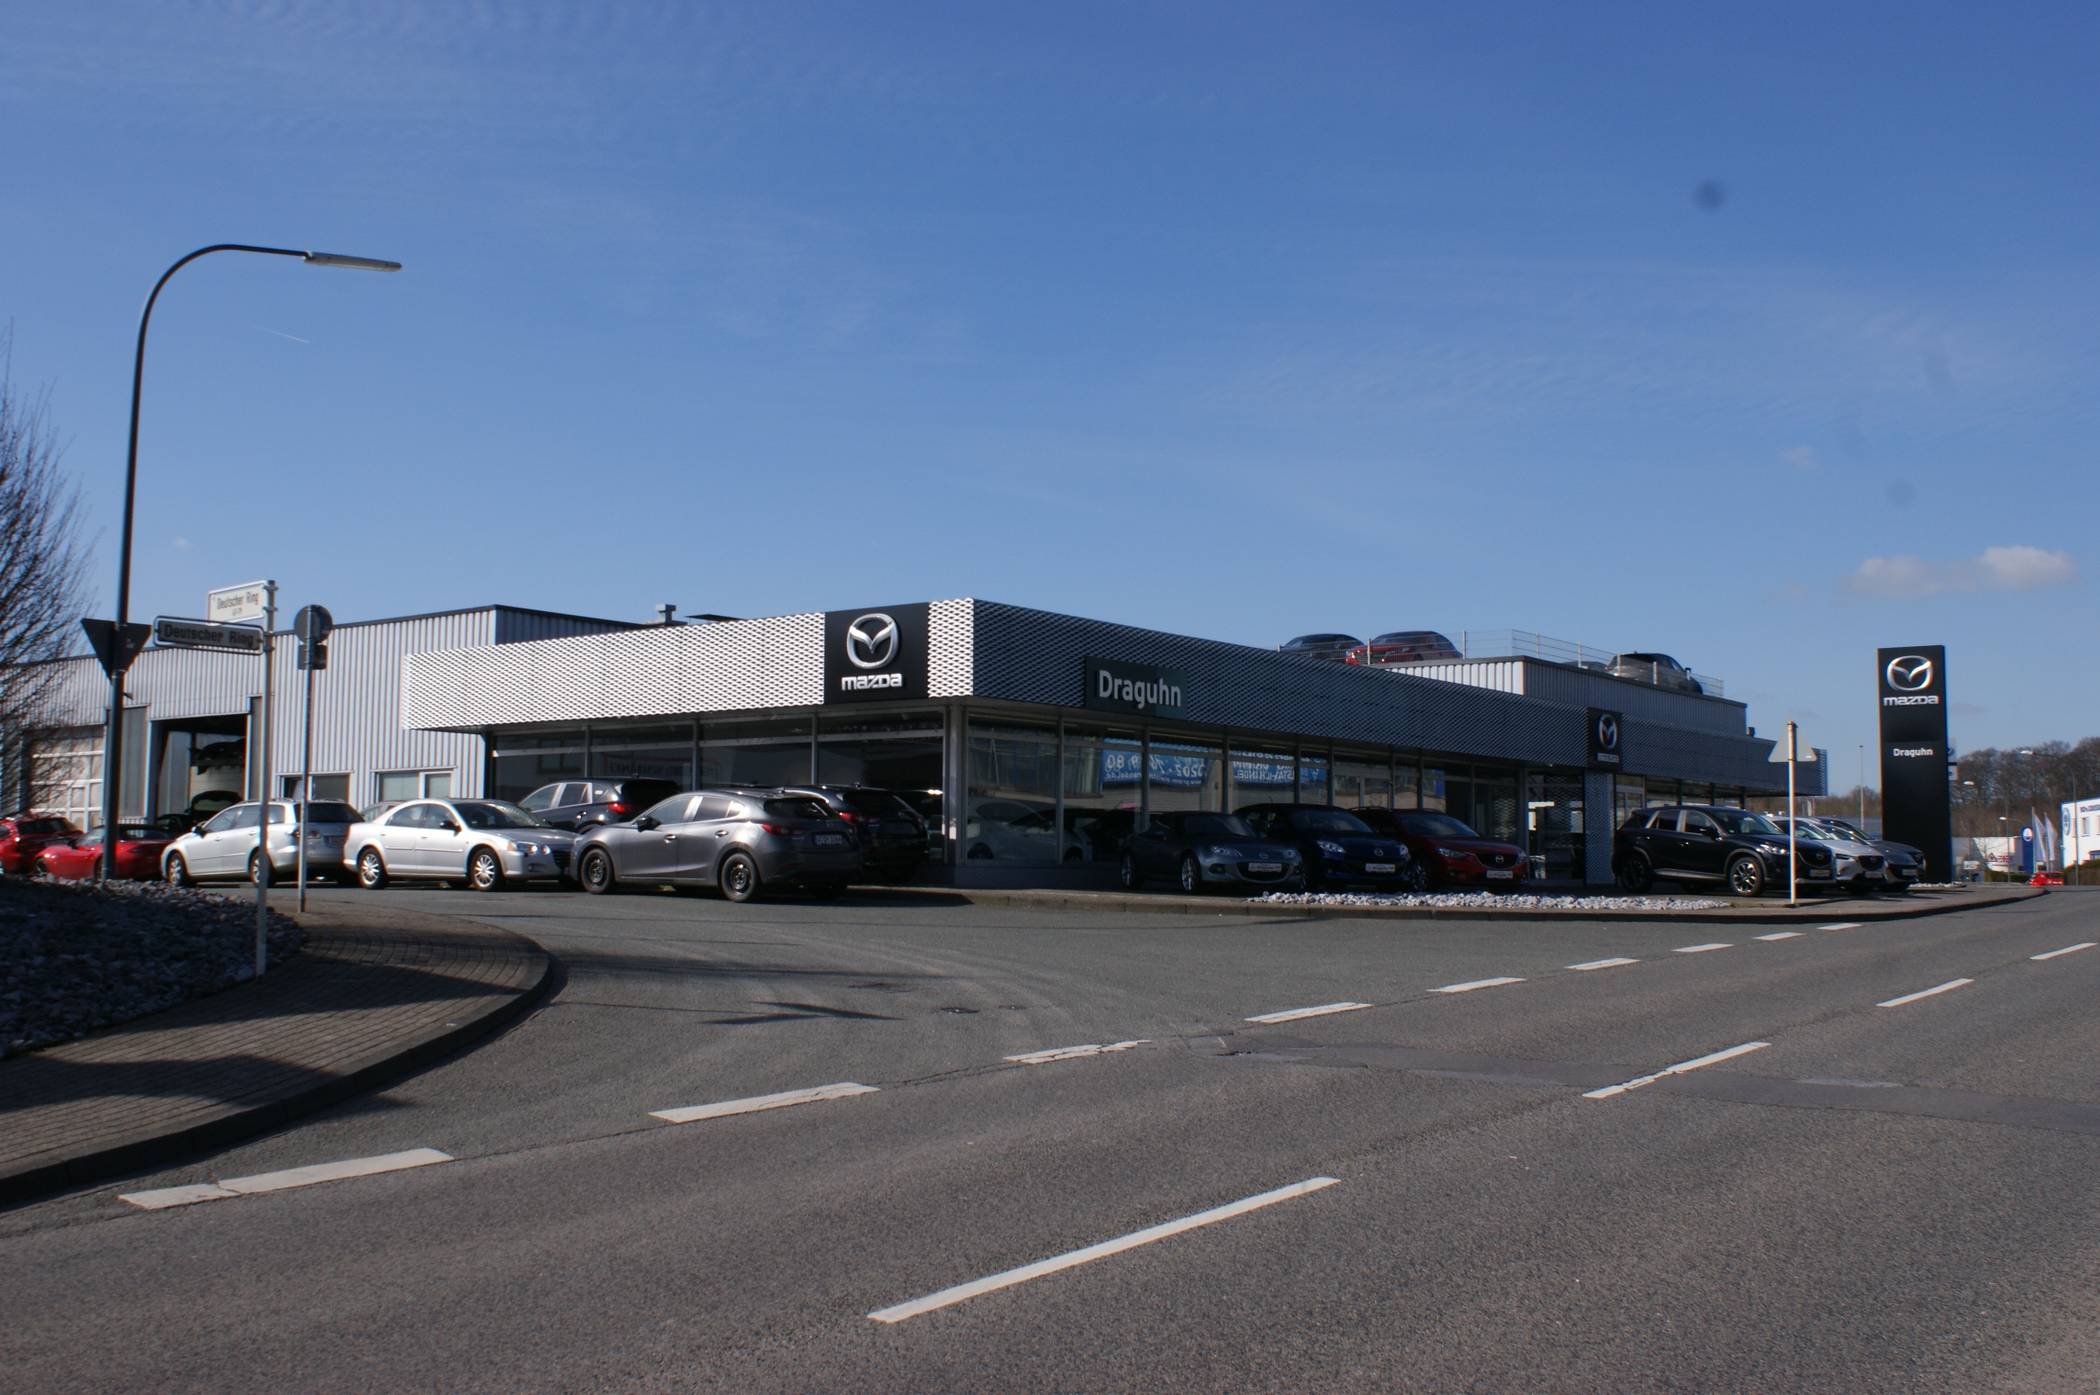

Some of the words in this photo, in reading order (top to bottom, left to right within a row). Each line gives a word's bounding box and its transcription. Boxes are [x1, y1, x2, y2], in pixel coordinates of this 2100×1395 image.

[164, 624, 224, 642] Deutscher
[229, 630, 254, 647] Ring
[841, 673, 903, 691] mazda
[1099, 669, 1181, 710] Draguhn
[1883, 695, 1939, 707] mazda
[1893, 748, 1933, 758] Draguhn
